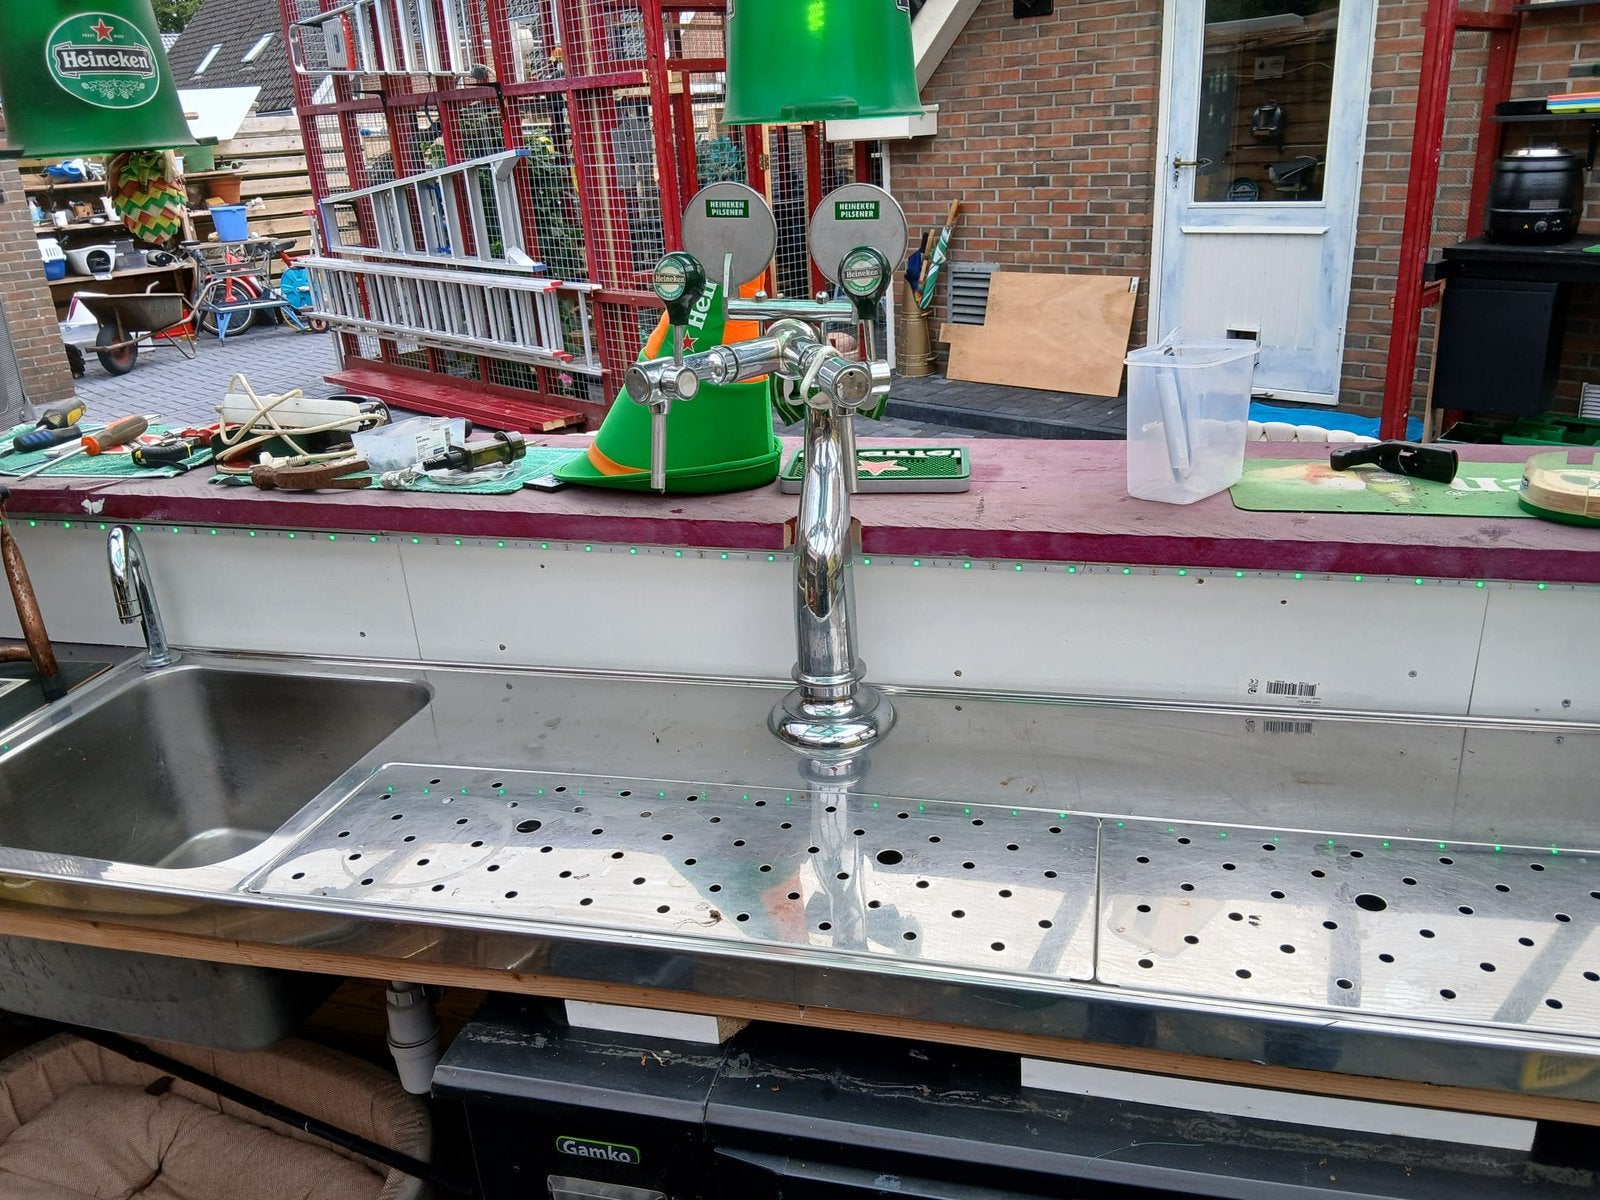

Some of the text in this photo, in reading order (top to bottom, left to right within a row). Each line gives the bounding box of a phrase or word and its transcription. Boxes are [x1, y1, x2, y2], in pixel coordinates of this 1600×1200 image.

[61, 50, 149, 69] Heineken
[709, 201, 745, 209] HEINEKEN
[839, 202, 875, 210] HEINEKEN
[711, 209, 744, 217] PILSENER
[840, 210, 874, 218] PILSENER
[846, 268, 879, 278] Heineken
[655, 274, 685, 283] Heineken
[562, 1140, 631, 1163] Gamko
